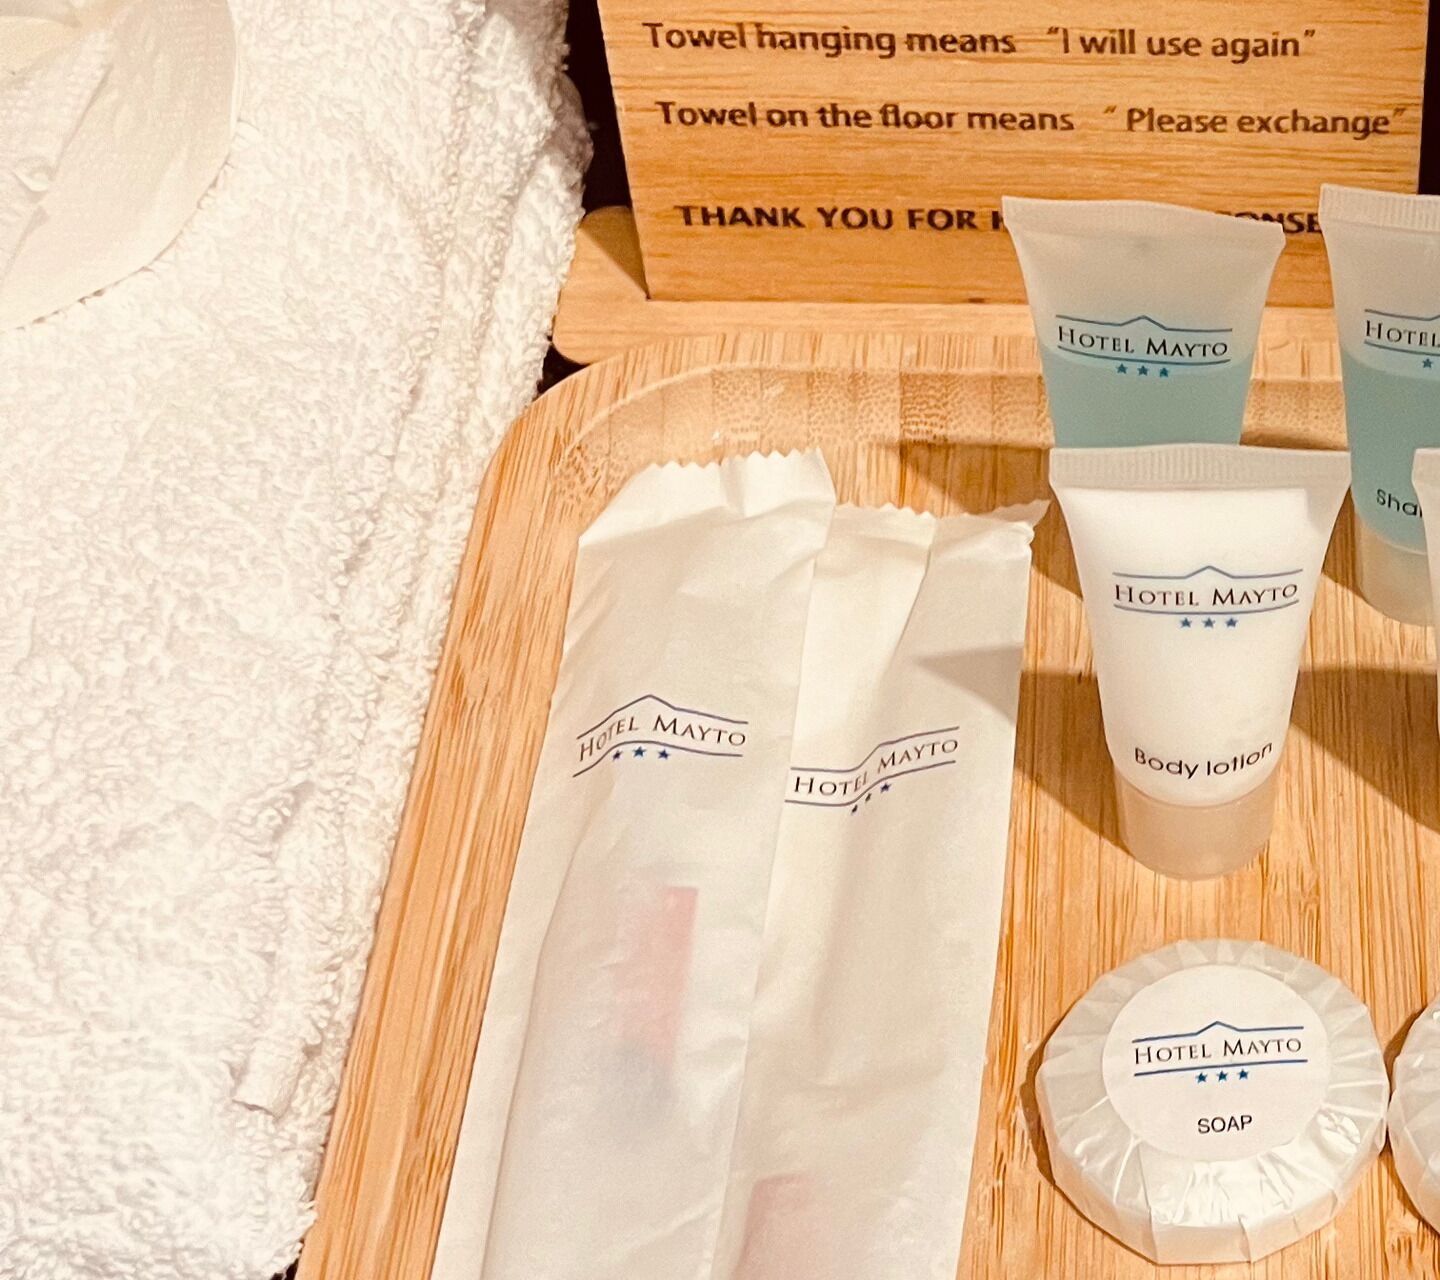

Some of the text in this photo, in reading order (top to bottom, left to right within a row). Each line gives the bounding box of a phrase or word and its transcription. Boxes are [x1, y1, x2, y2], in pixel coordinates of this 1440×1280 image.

[642, 21, 747, 50] Towel
[754, 21, 897, 60] hanging
[904, 33, 1018, 55] means
[1079, 28, 1137, 55] will
[1146, 36, 1203, 57] use
[655, 101, 758, 128] Towel
[765, 109, 809, 128] on
[815, 103, 873, 129] the
[878, 103, 957, 130] floor
[966, 111, 1075, 132] means
[673, 205, 806, 228] THANK
[816, 206, 894, 231] YOU
[907, 208, 979, 232] FOR
[1056, 326, 1230, 358] HOTEL MAYTO
[1376, 488, 1423, 519] Sha
[1114, 582, 1298, 607] HOTEL MAYTO
[578, 713, 747, 763] HOTEL MAYTO
[793, 739, 959, 798] HOTEL MAYTO
[1134, 741, 1273, 780] Body lotion
[1134, 1036, 1302, 1066] HOTEL MAYTO
[1197, 1114, 1253, 1135] SOAP
